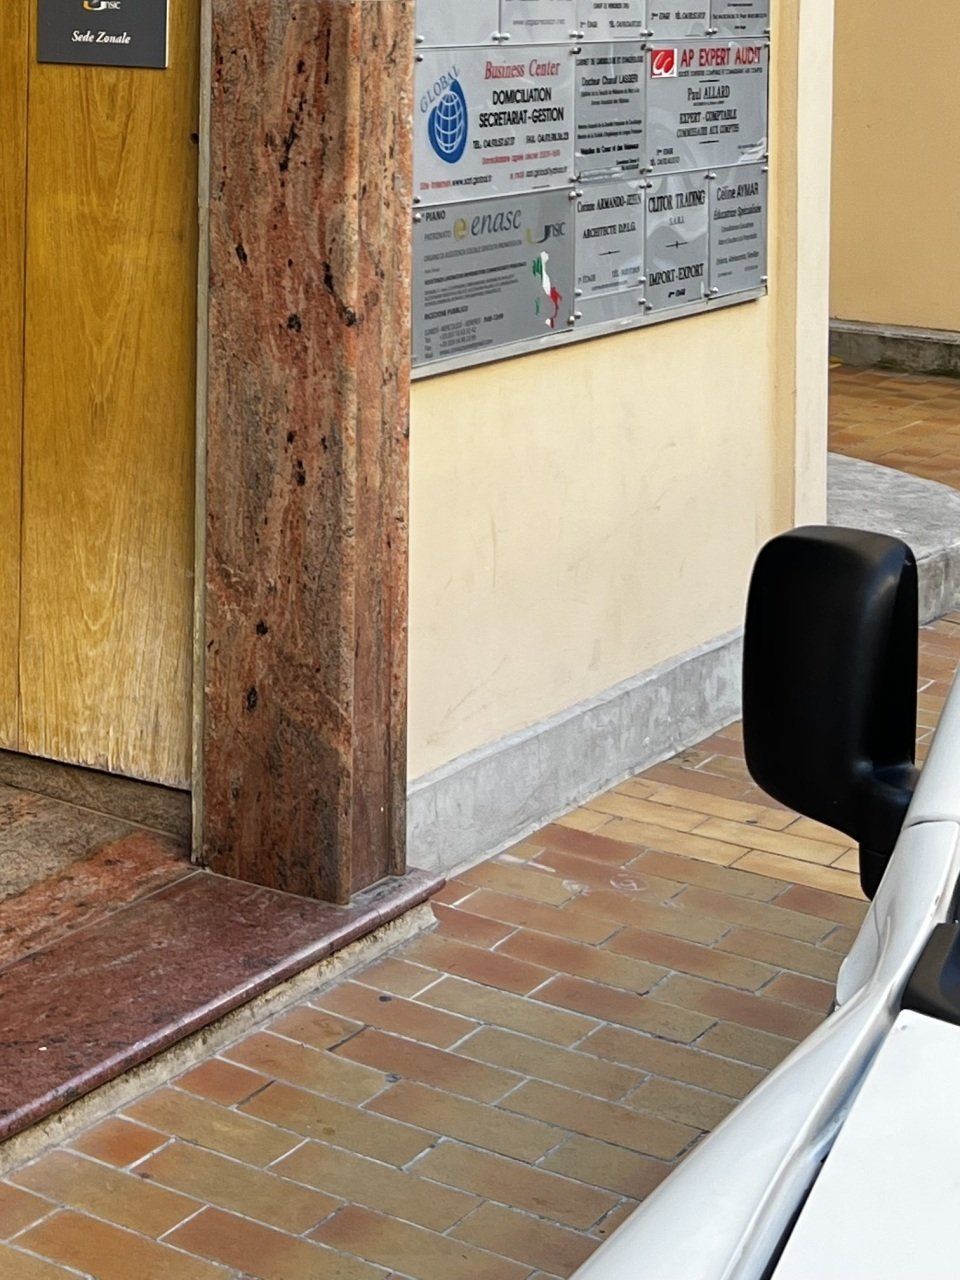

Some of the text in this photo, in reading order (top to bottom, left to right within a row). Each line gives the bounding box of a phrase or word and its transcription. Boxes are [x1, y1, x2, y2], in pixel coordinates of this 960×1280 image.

[72, 31, 131, 44] Sede Zonale
[680, 46, 762, 67] AP EXPERT AUDIT
[484, 61, 525, 80] Business
[529, 59, 560, 77] Center
[420, 64, 461, 114] GLOBAL
[492, 87, 552, 105] DOMICILIATION
[687, 85, 730, 101] Paul ALLARD
[479, 107, 564, 128] SECRETARIAT-GESTION
[425, 210, 446, 221] PIANO
[471, 209, 522, 237] enasc
